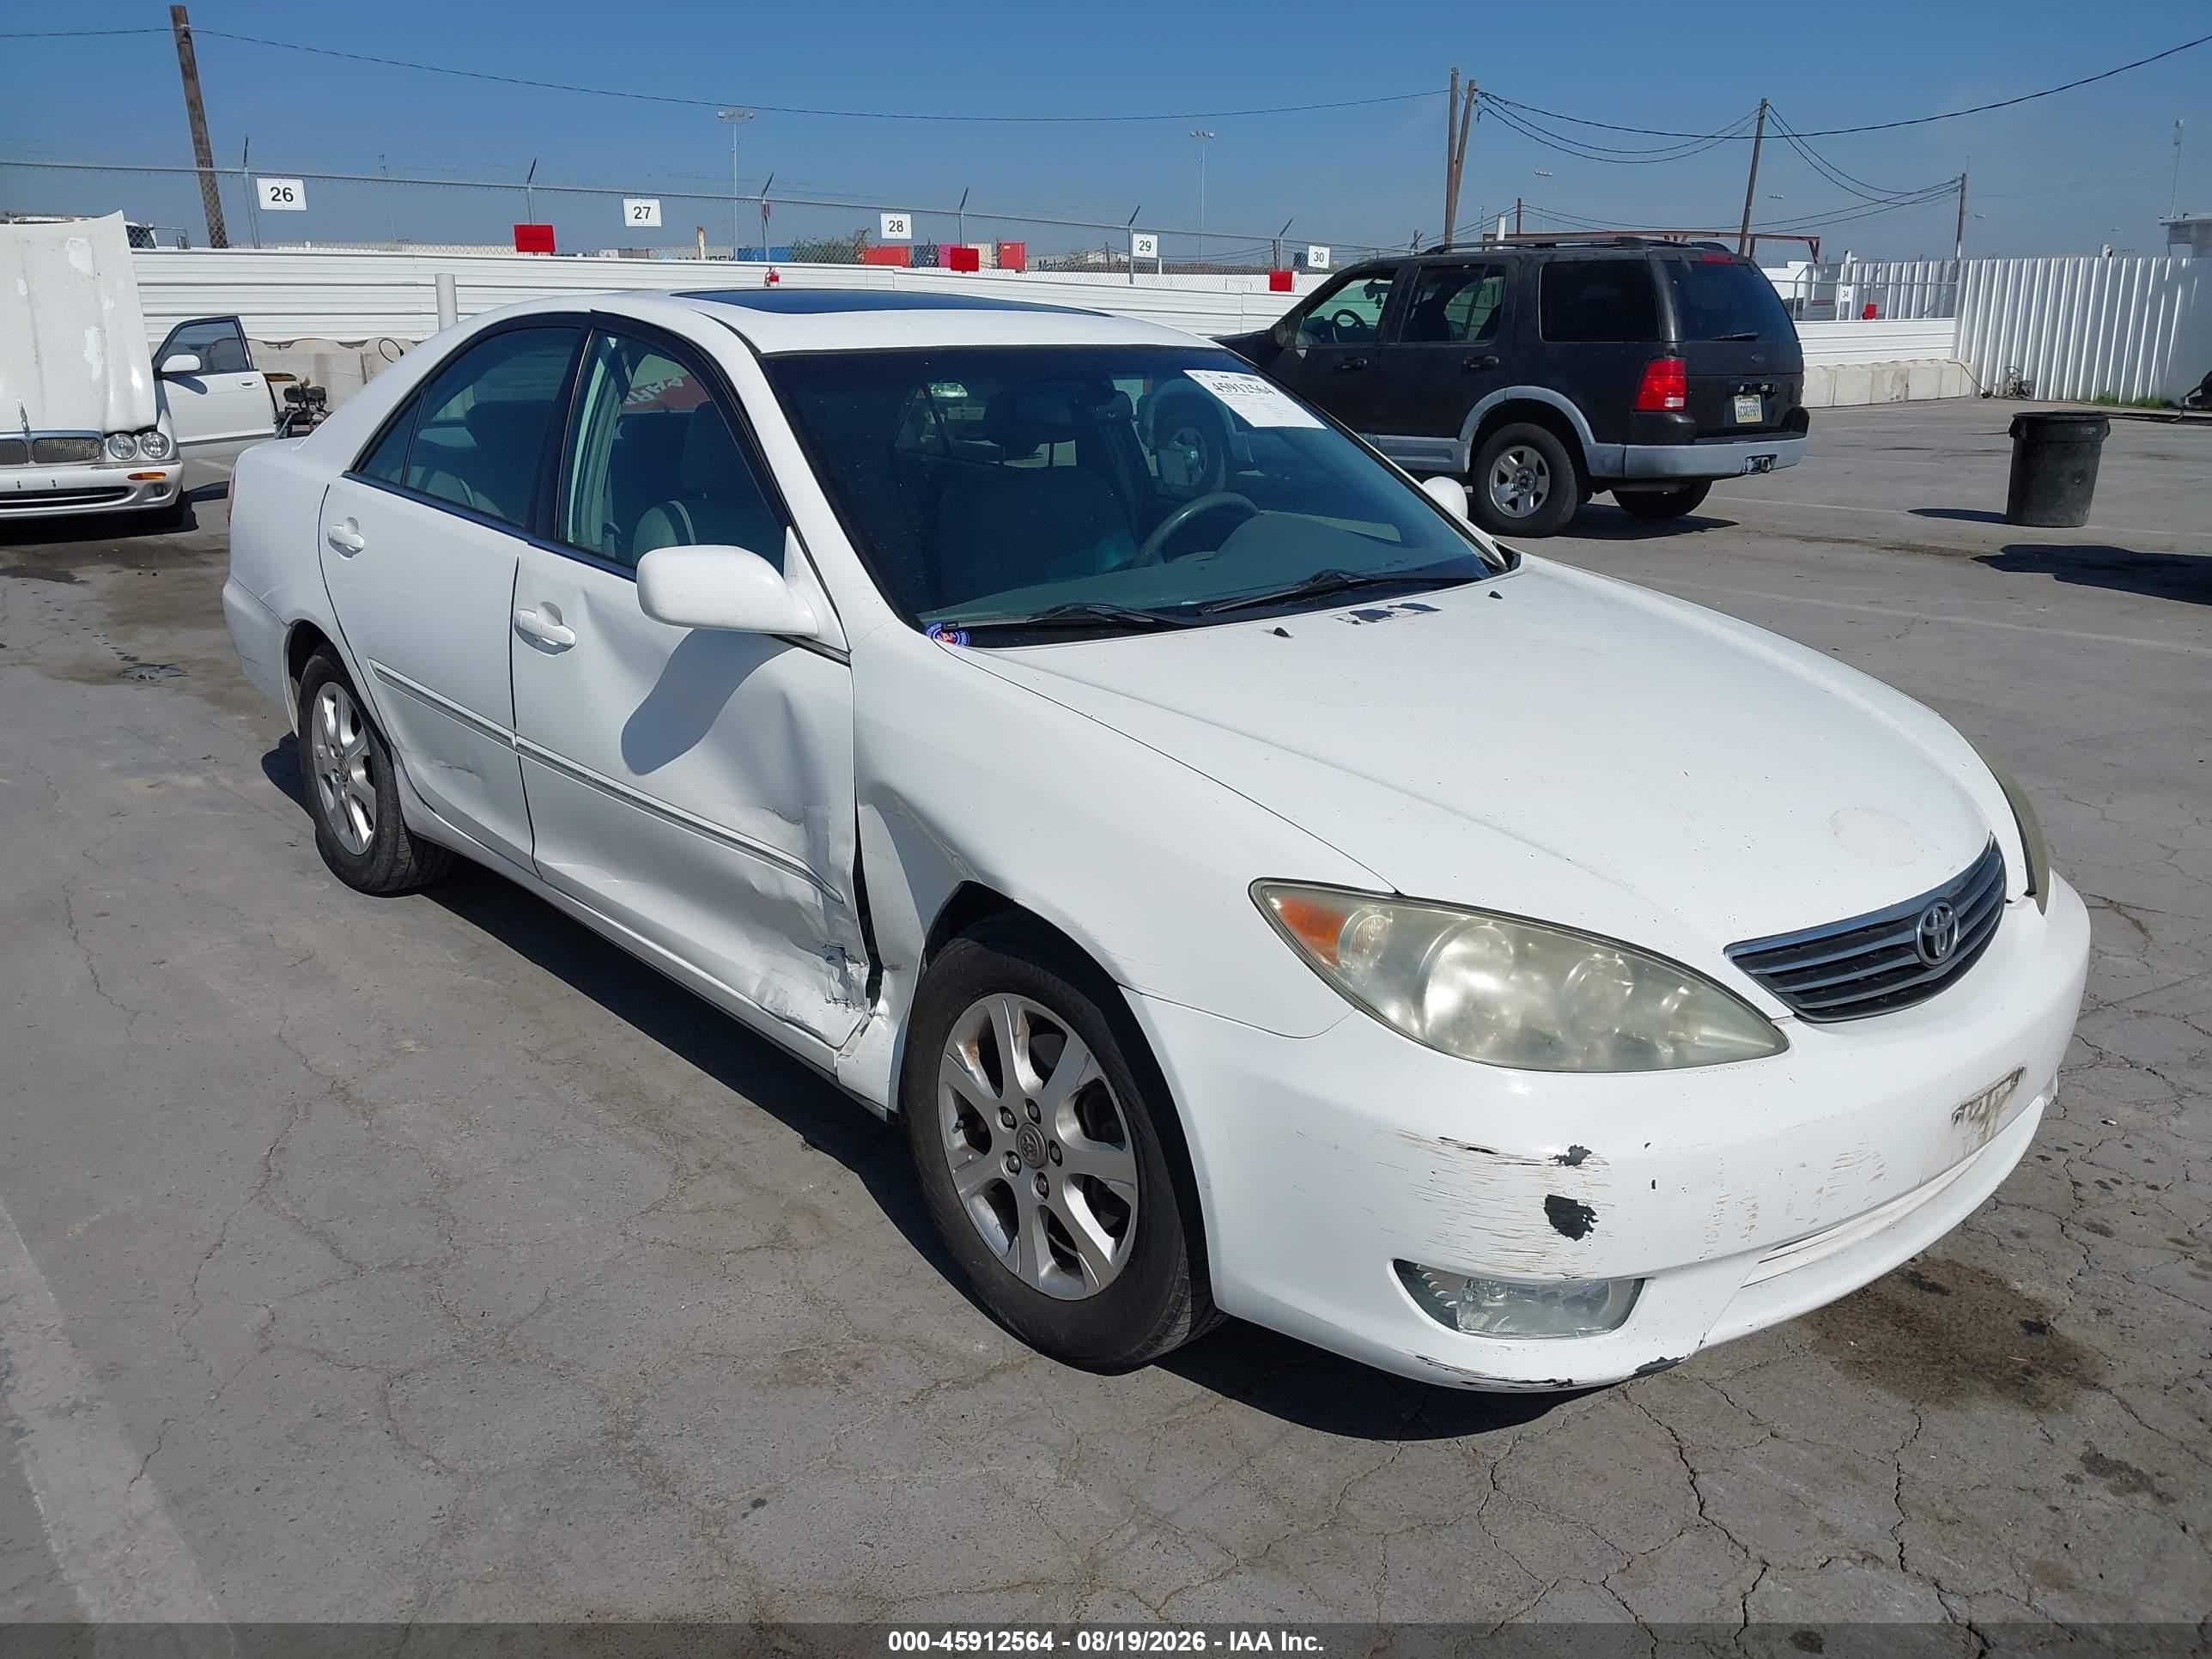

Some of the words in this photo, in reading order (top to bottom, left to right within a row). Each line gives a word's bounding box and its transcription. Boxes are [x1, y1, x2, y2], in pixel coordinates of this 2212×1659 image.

[270, 186, 294, 202] 26
[634, 206, 651, 219] 27
[889, 220, 903, 232] 28
[1139, 240, 1152, 252] 29
[1314, 252, 1324, 262] 30
[1212, 381, 1276, 396] 45912564
